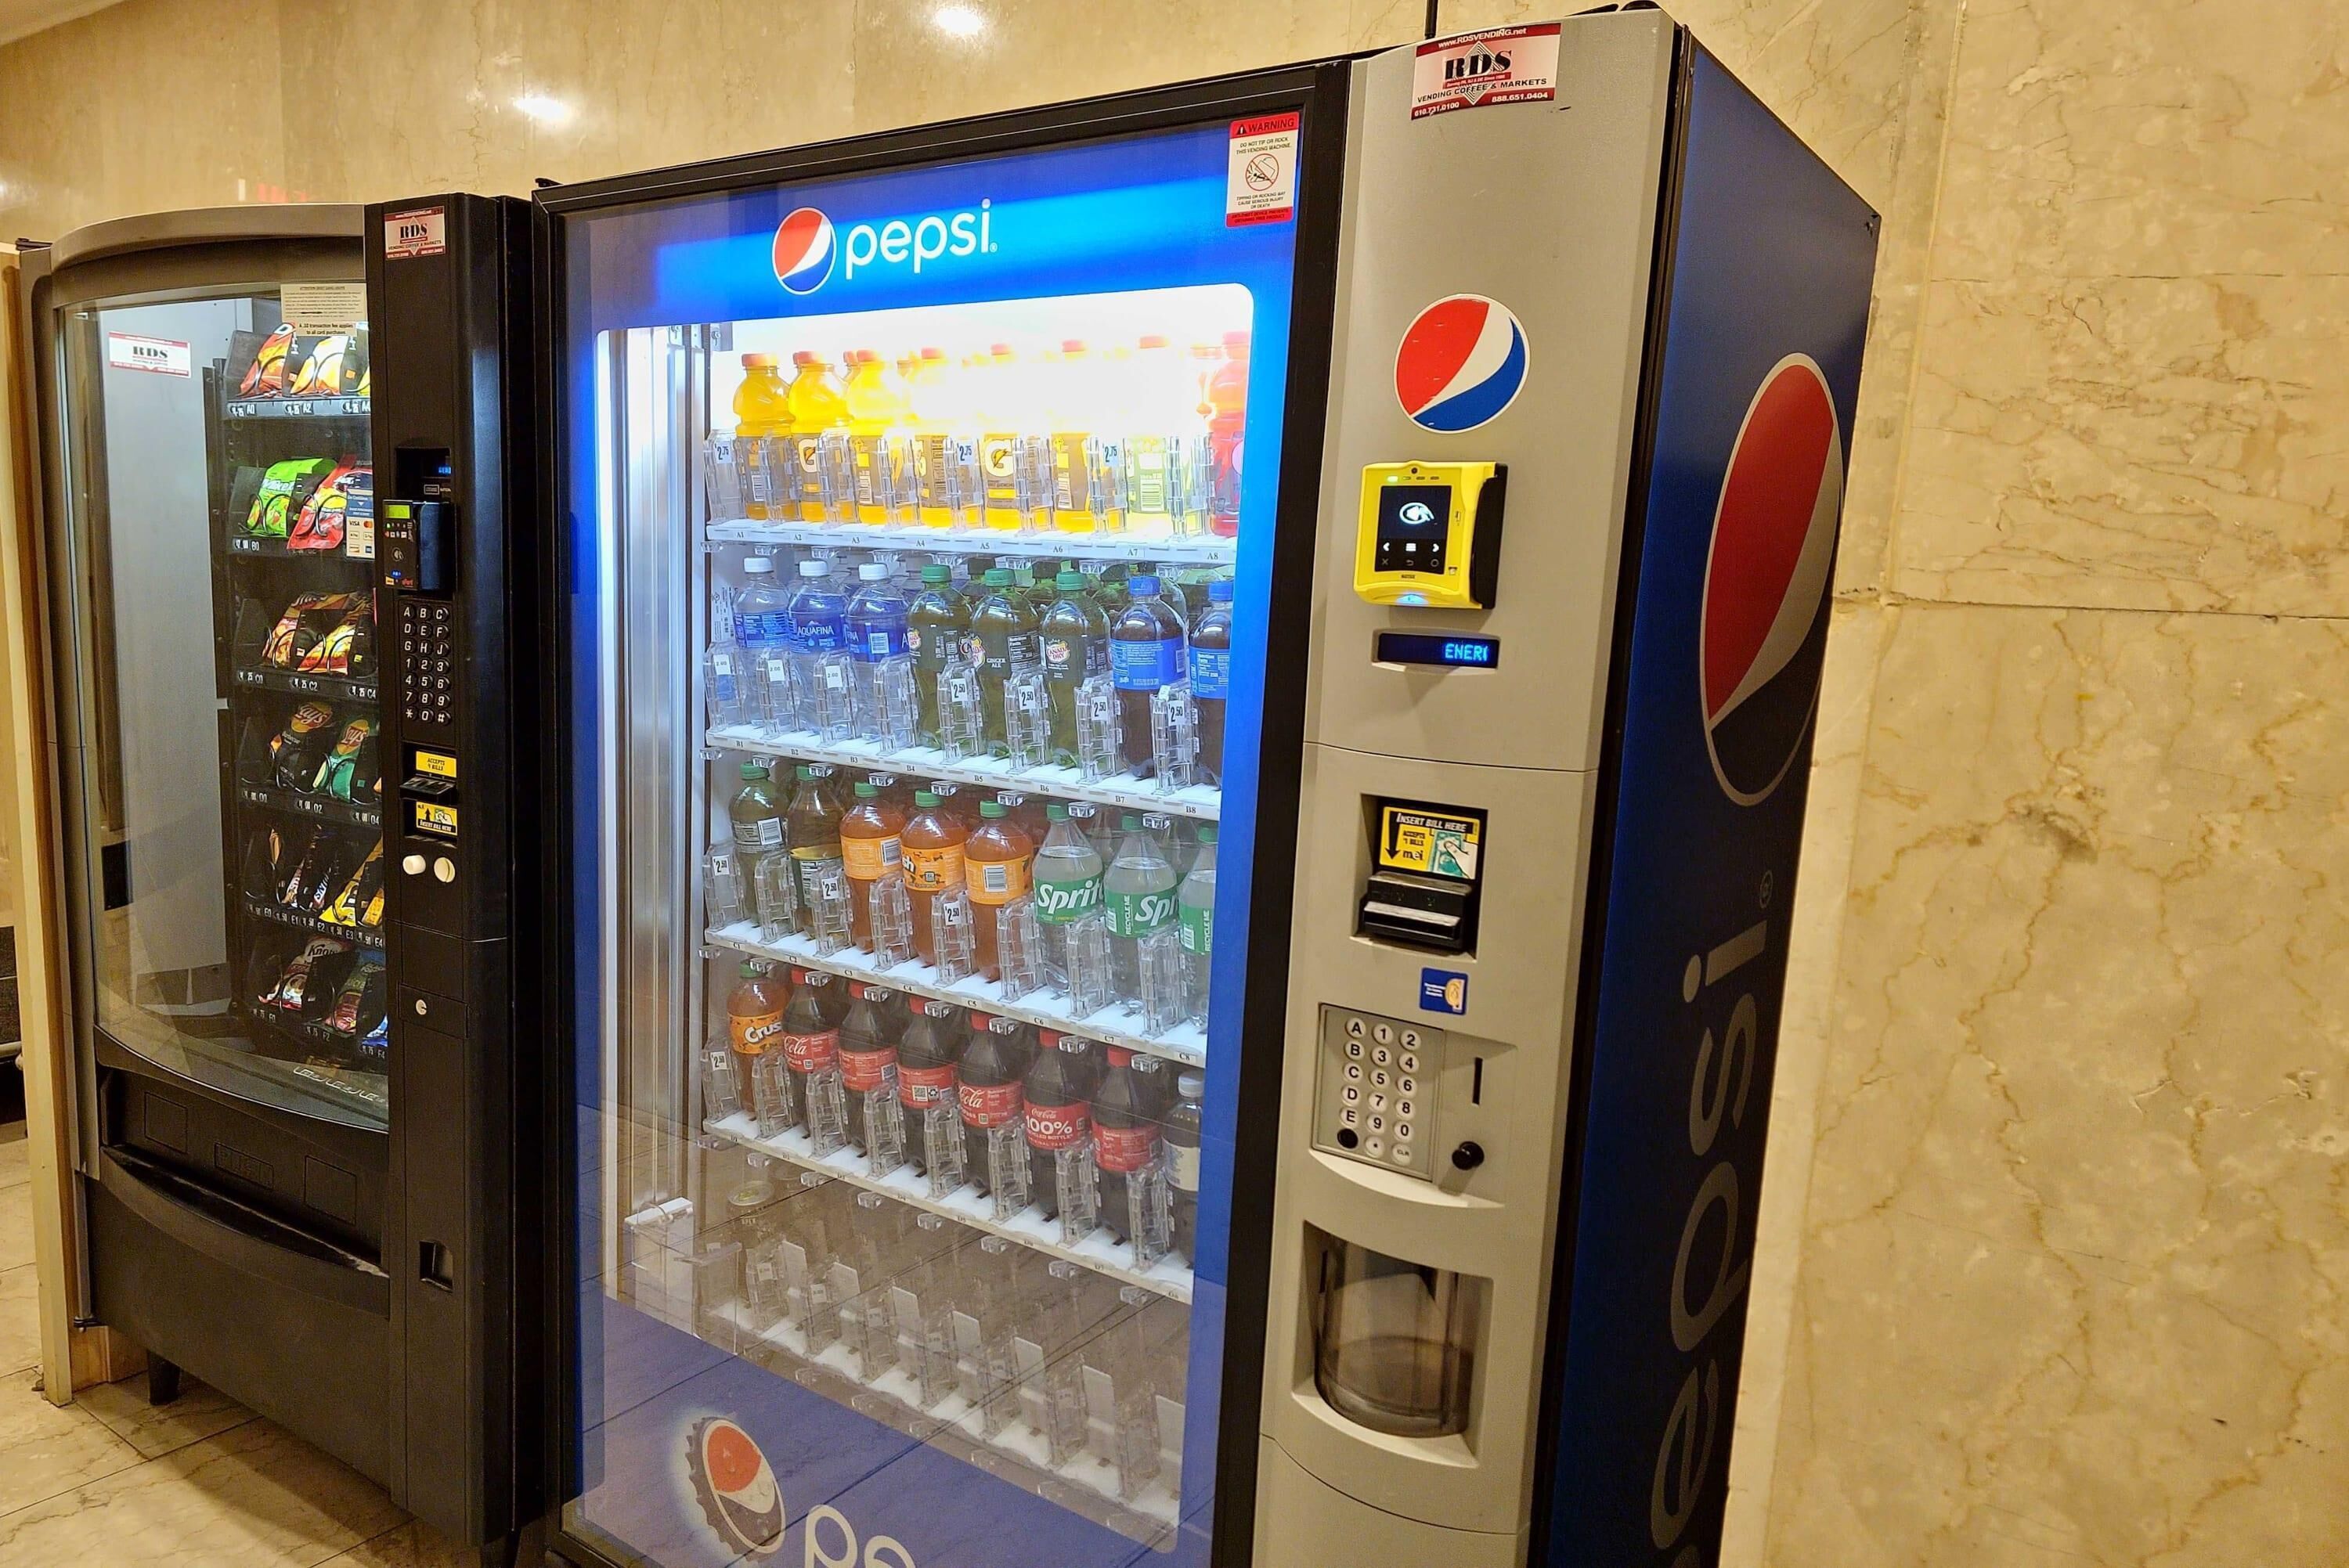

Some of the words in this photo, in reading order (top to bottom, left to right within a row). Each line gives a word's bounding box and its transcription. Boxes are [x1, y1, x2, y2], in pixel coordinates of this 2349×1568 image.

[1438, 28, 1526, 49] www.RDSVENDING.net
[1445, 50, 1512, 80] RDS
[1417, 89, 1452, 103] VENDING
[1454, 84, 1488, 95] COFFEE
[1500, 78, 1547, 88] MARKETS
[1492, 92, 1548, 103] 888.651.0404
[1248, 118, 1294, 132] WARNING
[400, 222, 428, 239] RDS
[846, 197, 991, 279] pepsi
[132, 346, 168, 359] RDS
[1052, 545, 1063, 553] A6
[403, 607, 410, 618] A
[420, 607, 427, 618] B
[435, 609, 443, 620] C
[420, 625, 427, 636] E
[436, 626, 443, 637] F
[798, 625, 835, 636] AQUAFINA
[847, 631, 859, 642] FINA
[404, 641, 412, 651] G
[420, 643, 428, 654] H
[437, 644, 443, 655] J
[406, 658, 411, 668] 1
[421, 660, 428, 670] 2
[437, 661, 443, 672] 3
[405, 675, 412, 685] 4
[421, 676, 428, 687] 5
[437, 679, 444, 689] 6
[406, 691, 413, 701] 7
[421, 694, 428, 704] 8
[438, 696, 445, 706] 9
[438, 713, 446, 723] #
[1185, 806, 1196, 814] B8
[420, 819, 433, 827] INSERT
[1396, 813, 1426, 826] INSERT
[1425, 819, 1443, 829] BILL
[1444, 822, 1467, 832] HERE
[1403, 849, 1423, 861] mei
[1124, 895, 1131, 907] ME
[291, 915, 298, 925] E1
[1203, 910, 1210, 921] ME
[317, 922, 326, 932] E2
[345, 929, 353, 939] E3
[374, 937, 382, 947] E4
[745, 1021, 781, 1043] Crus
[1351, 1021, 1362, 1034] A
[1380, 1028, 1386, 1040] 1
[1406, 1033, 1416, 1047] 2
[1350, 1044, 1361, 1057] B
[1378, 1051, 1387, 1062] 3
[1405, 1057, 1413, 1069] 4
[1348, 1065, 1359, 1079] C
[1377, 1072, 1385, 1085] 5
[1403, 1079, 1413, 1091] 6
[1348, 1088, 1357, 1100] D
[1375, 1094, 1384, 1107] 7
[1402, 1101, 1411, 1114] 8
[1026, 1115, 1073, 1135] 100%
[1347, 1110, 1356, 1123] E
[1373, 1116, 1382, 1130] 9
[1400, 1124, 1409, 1137] 0
[1650, 920, 1770, 1568] epsi
